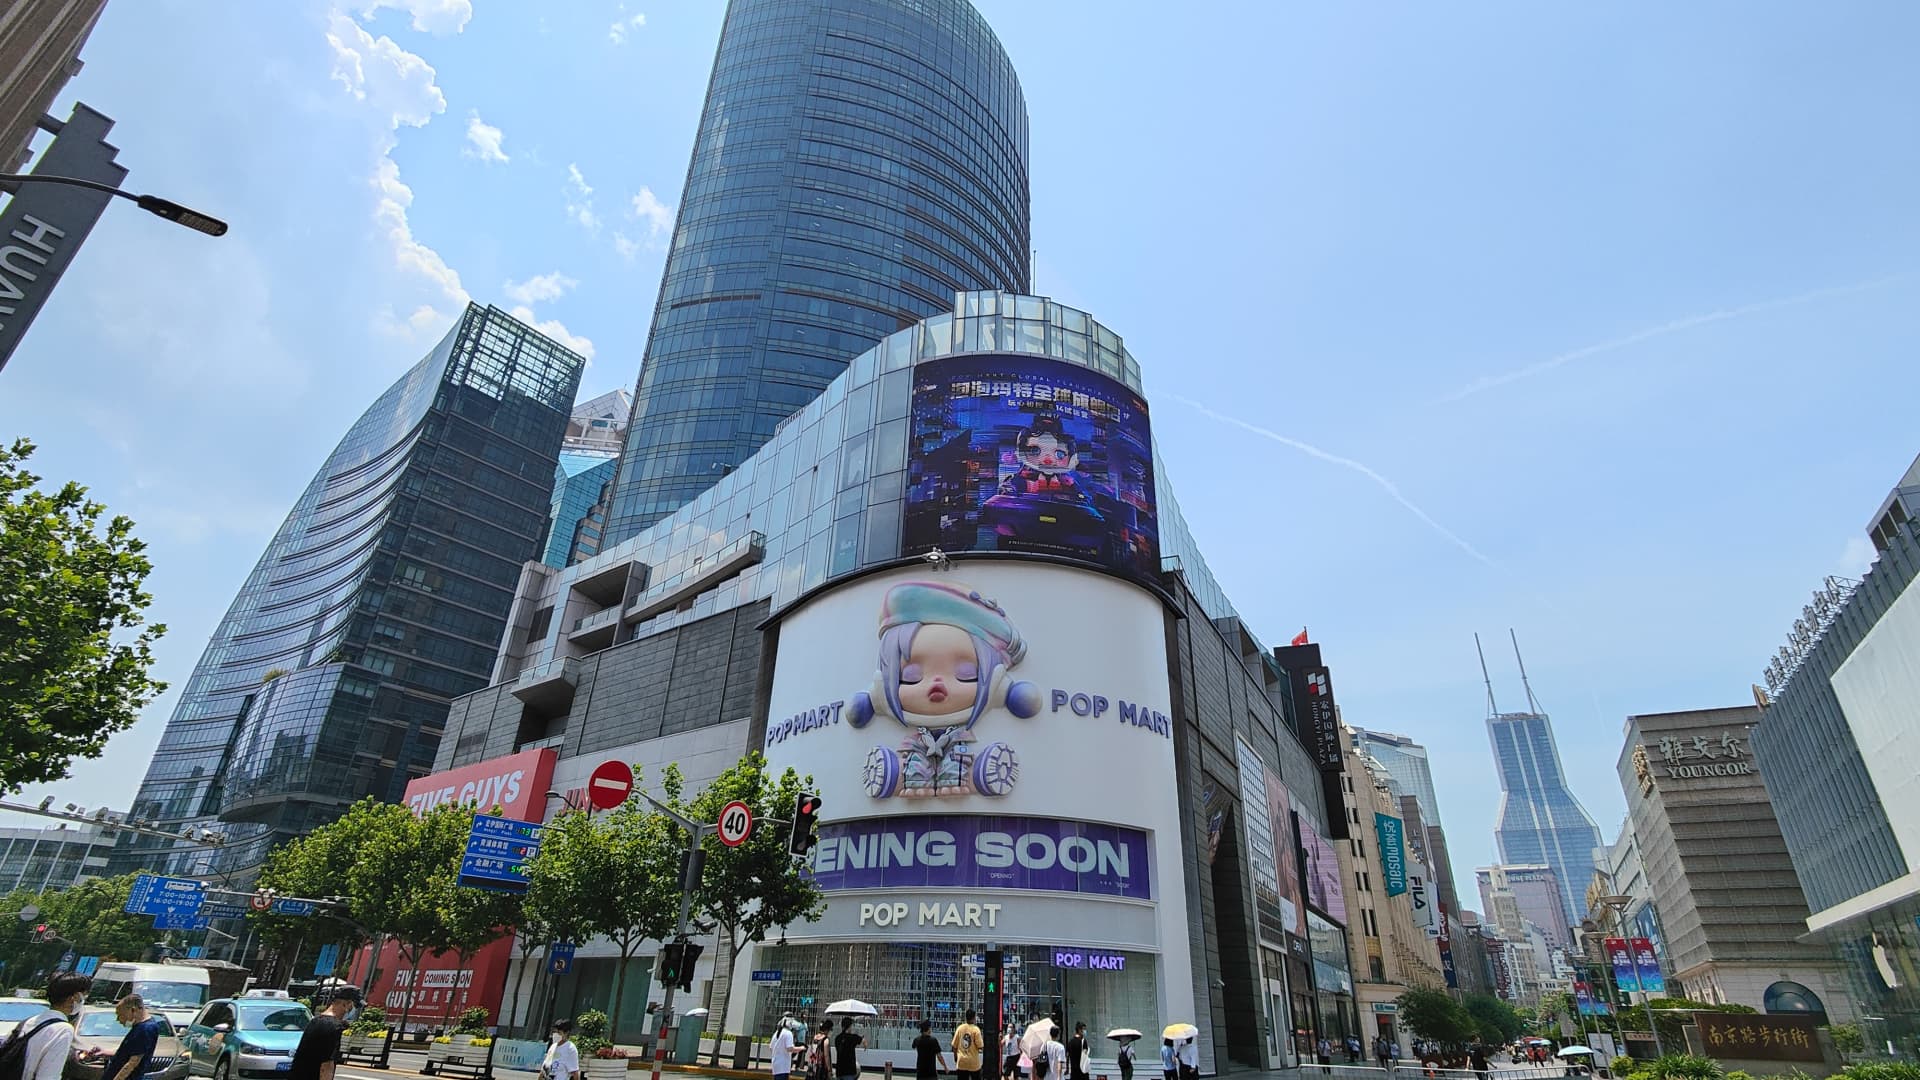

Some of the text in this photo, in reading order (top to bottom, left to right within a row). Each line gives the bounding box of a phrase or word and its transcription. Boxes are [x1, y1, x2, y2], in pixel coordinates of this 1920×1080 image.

[0, 213, 66, 331] HUA
[1051, 689, 1171, 739] POP MART
[1659, 731, 1745, 766] 雅戈尔
[1667, 761, 1752, 779] YOUNGOR
[458, 770, 521, 810] GUYS
[560, 787, 603, 817] JIN
[724, 811, 746, 835] 40
[808, 830, 1130, 878] ENING SOON
[1410, 876, 1426, 909] FILA
[859, 902, 1002, 929] POP MART
[1056, 952, 1125, 970] POP MART
[394, 970, 420, 987] FIVE
[450, 972, 473, 985] SON
[385, 990, 417, 1009] GUYS
[1708, 1024, 1809, 1048] 南京路步行街
